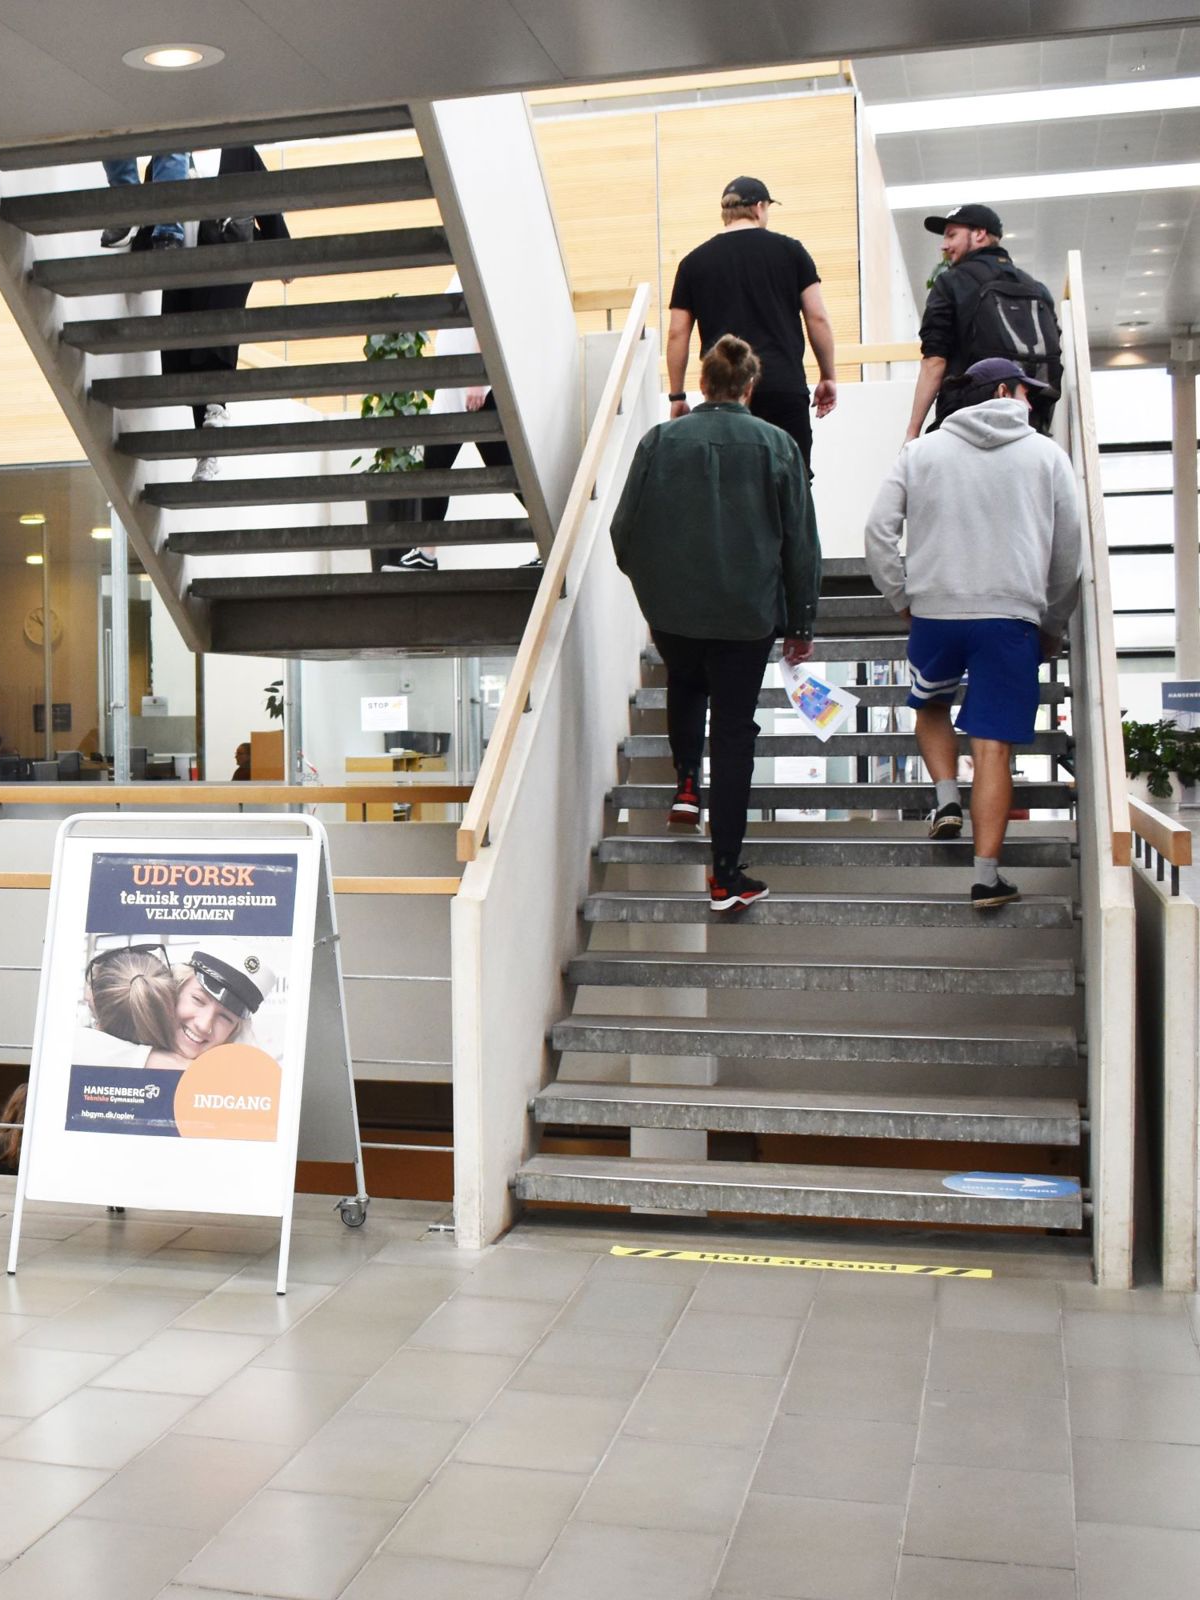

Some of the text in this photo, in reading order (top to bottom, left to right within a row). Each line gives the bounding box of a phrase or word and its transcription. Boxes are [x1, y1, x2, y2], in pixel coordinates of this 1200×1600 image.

[132, 864, 255, 887] UDFORSK
[120, 890, 277, 909] teknisk gymnasium
[145, 908, 235, 921] VELKOMMEN
[83, 1085, 145, 1097] HANSENBERG
[110, 1096, 145, 1104] Gymnasium
[193, 1093, 272, 1111] INDGANG
[81, 1110, 135, 1120] hbgym.dk/oplev
[699, 1253, 898, 1271] Hold afstand
